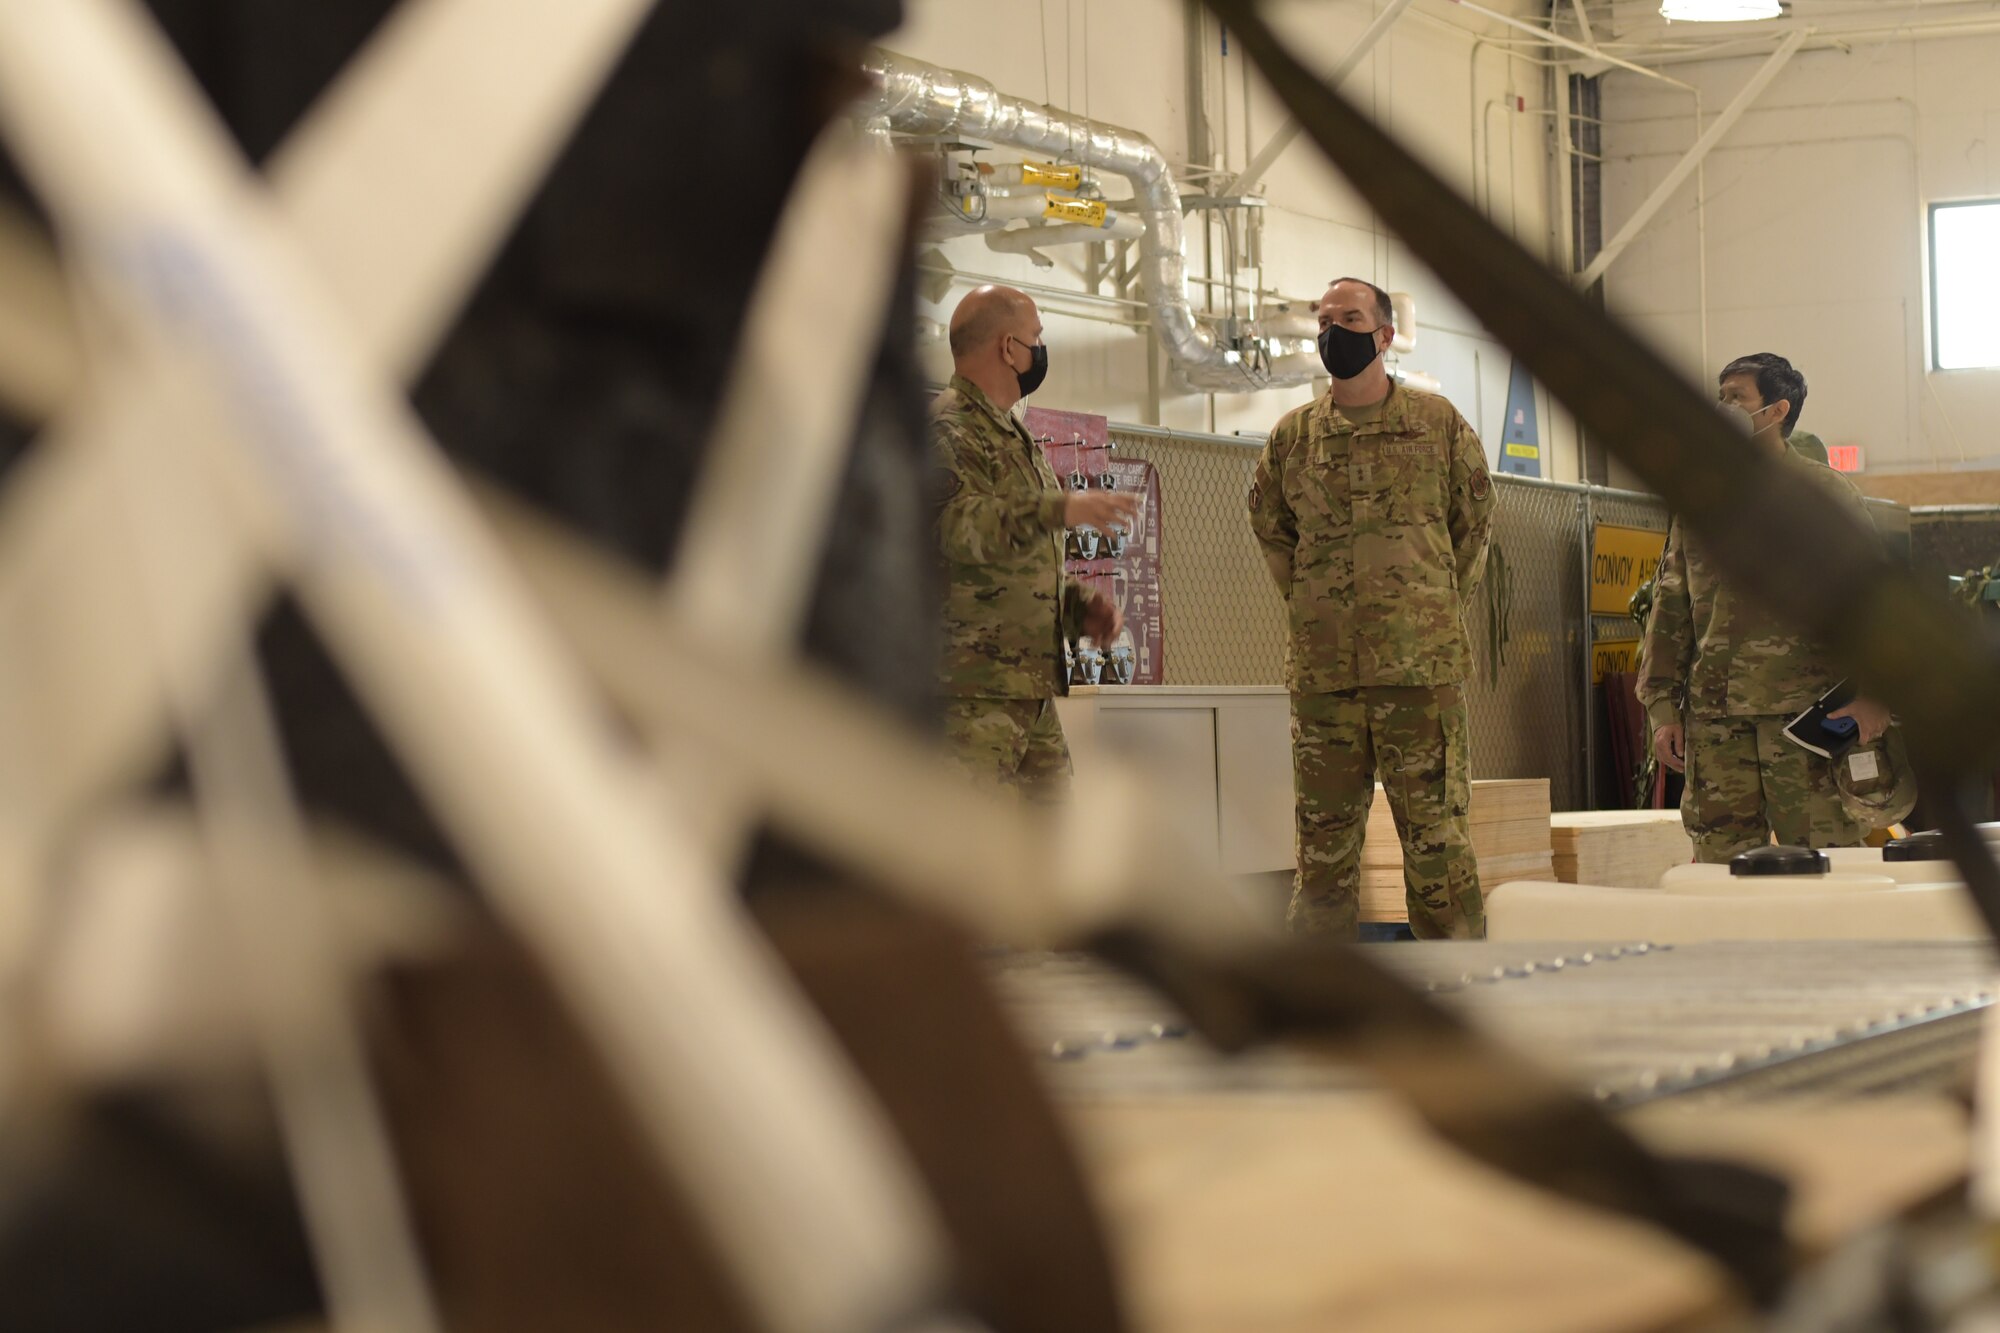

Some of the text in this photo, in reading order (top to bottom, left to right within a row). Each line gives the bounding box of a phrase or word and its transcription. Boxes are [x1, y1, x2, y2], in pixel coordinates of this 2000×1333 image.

[1401, 445, 1413, 455] AIR
[1414, 445, 1435, 455] FORCE
[1829, 446, 1858, 471] EXIT
[1595, 553, 1634, 587] CONVOY
[1596, 650, 1630, 675] CONVOY
